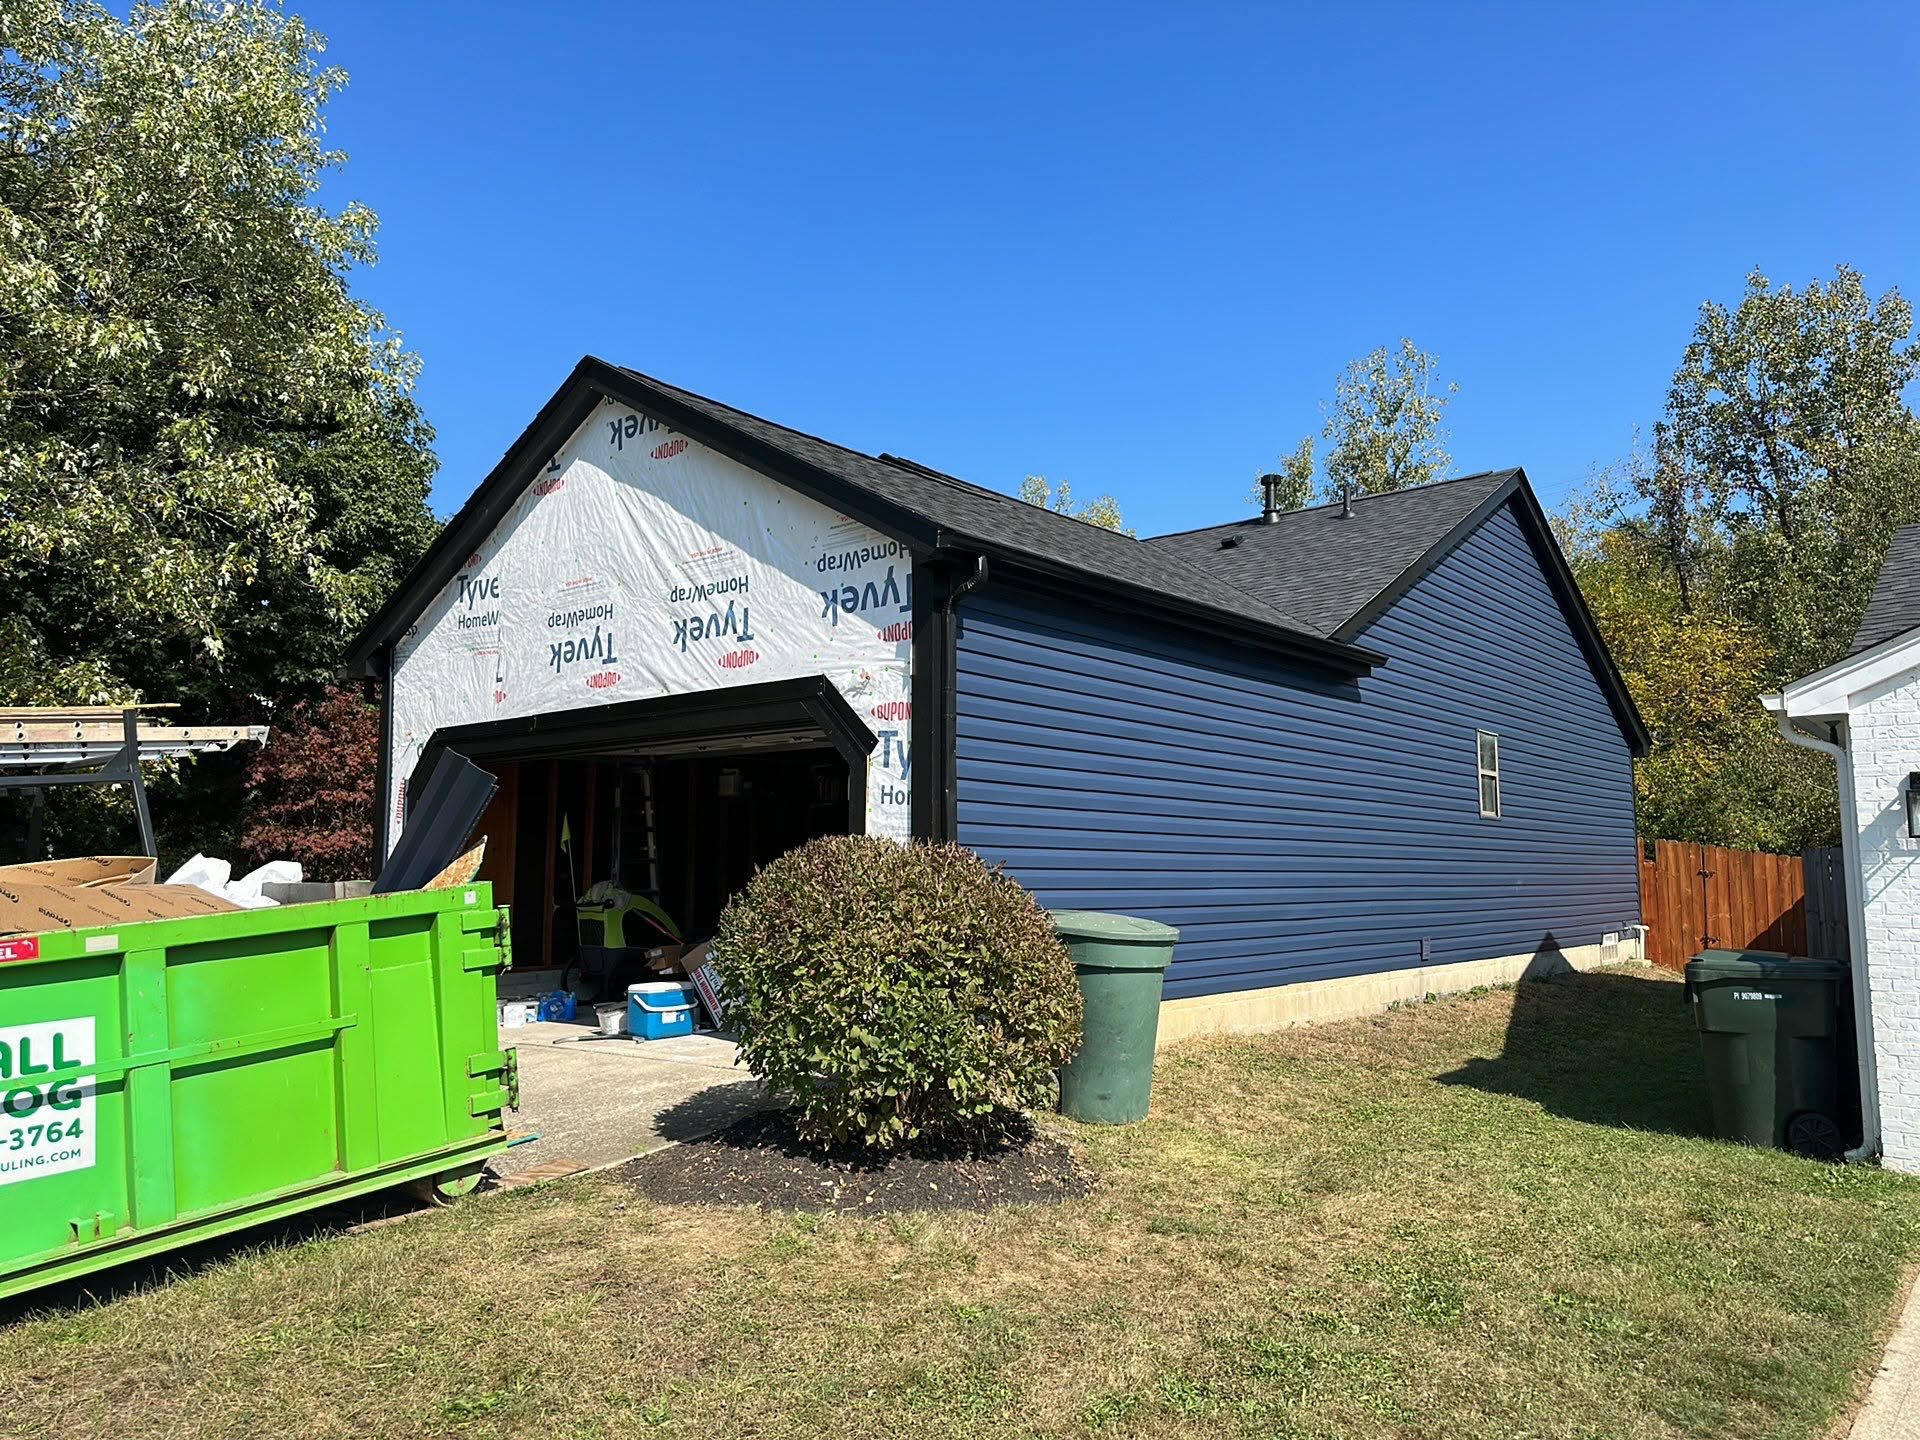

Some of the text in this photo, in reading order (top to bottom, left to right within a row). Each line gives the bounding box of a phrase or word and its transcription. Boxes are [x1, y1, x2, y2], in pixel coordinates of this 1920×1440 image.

[655, 440, 684, 459] DUPONT
[670, 575, 749, 602] HomeWrap
[548, 603, 613, 628] HomeWrap
[672, 600, 755, 652] Tyvek
[550, 626, 618, 673] Tyvek
[721, 650, 755, 669] DUPONT
[589, 671, 617, 689] DUPONT
[0, 1148, 81, 1172] ULING.COM
